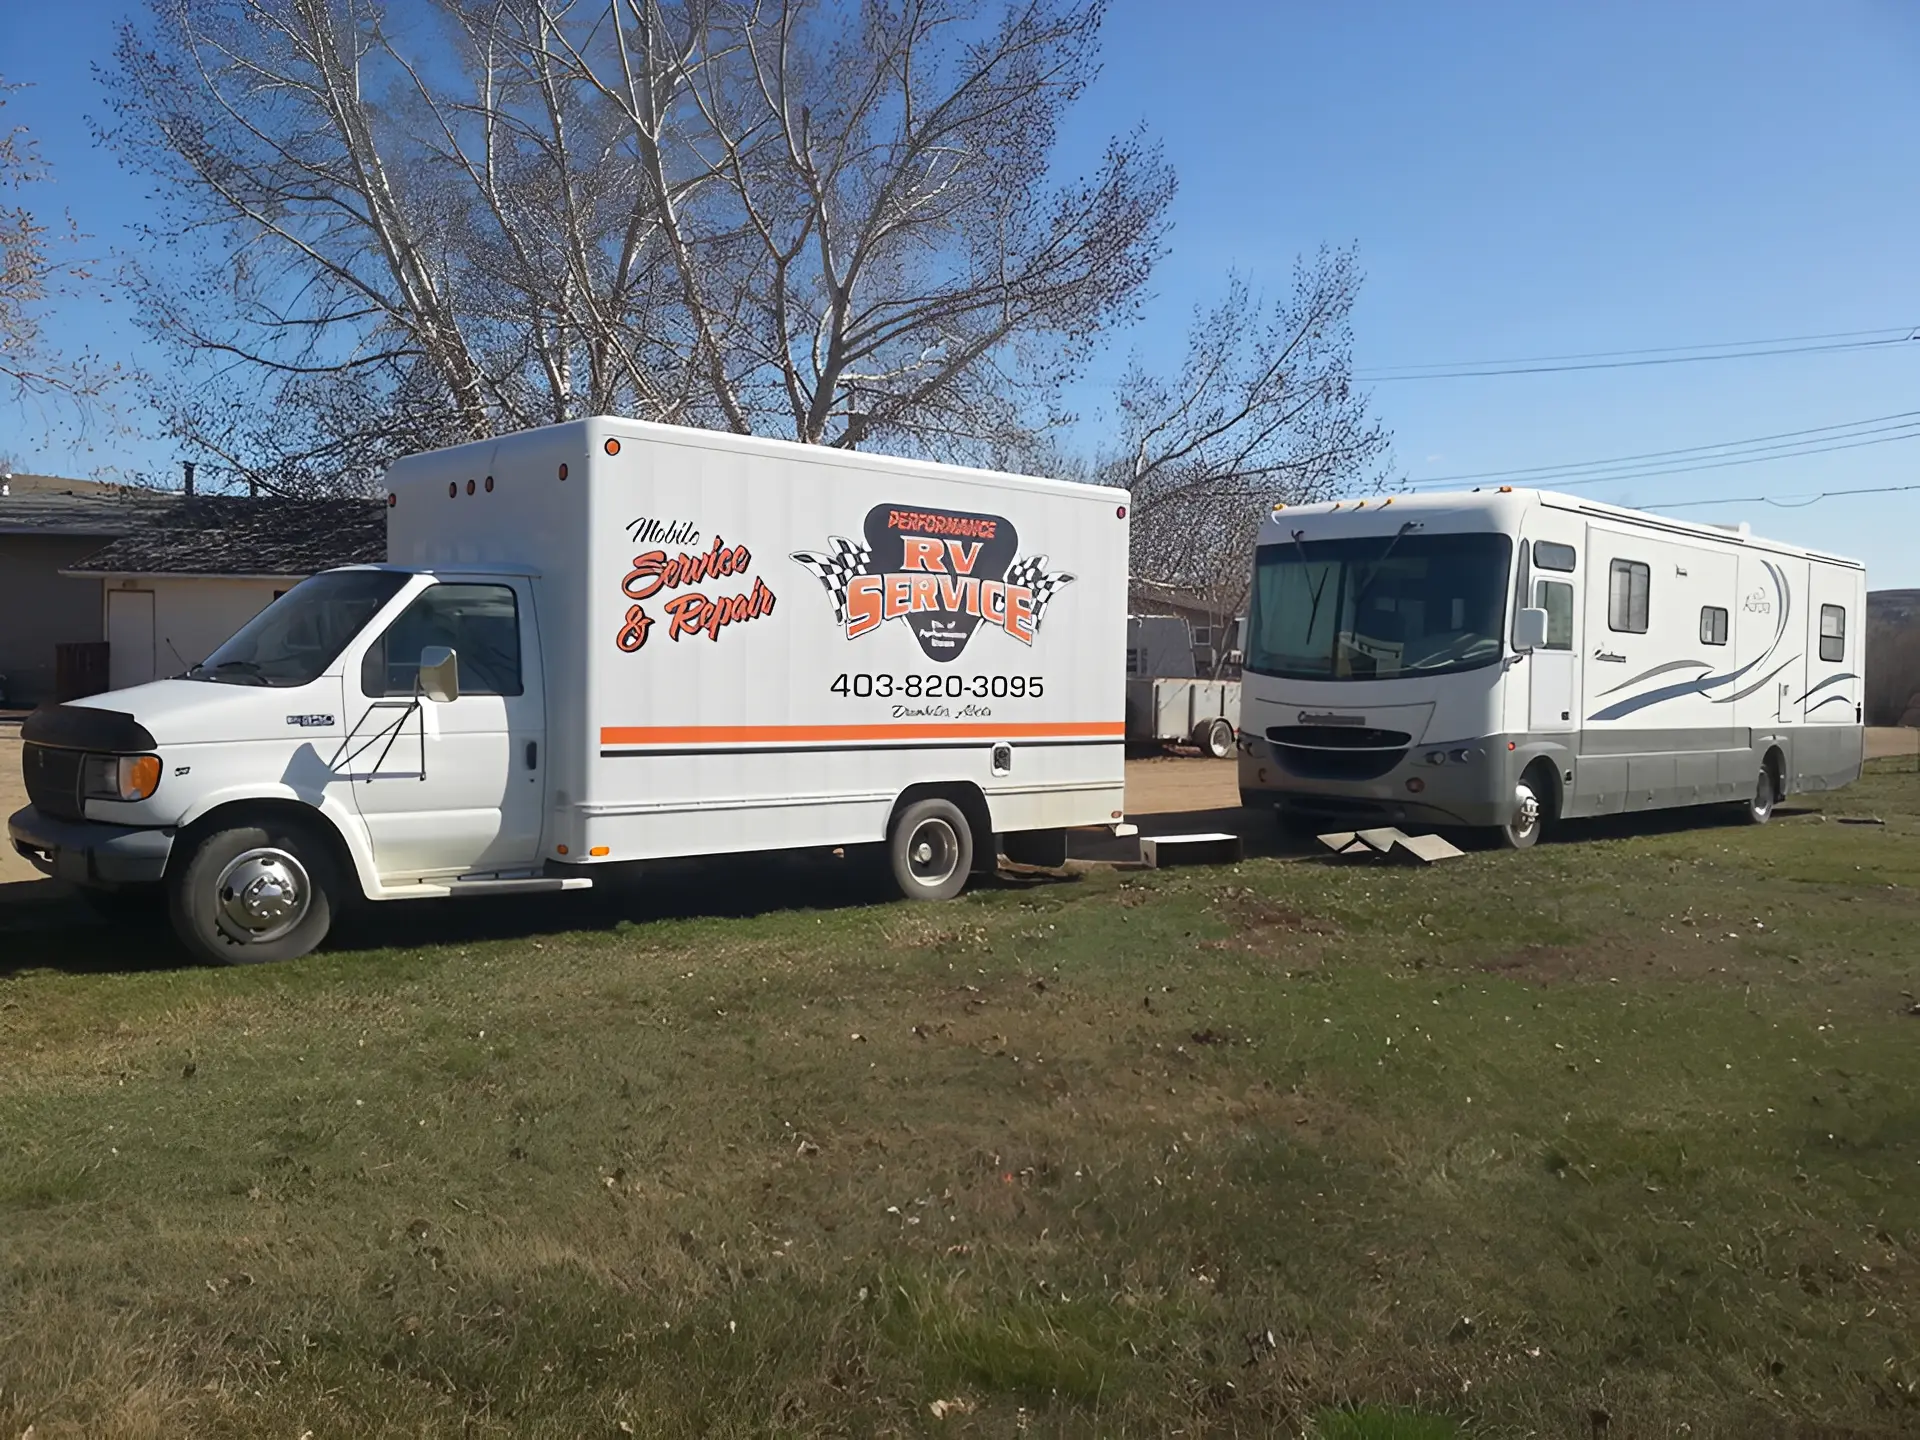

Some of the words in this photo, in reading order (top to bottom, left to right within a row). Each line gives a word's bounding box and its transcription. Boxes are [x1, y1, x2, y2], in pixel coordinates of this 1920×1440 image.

[887, 510, 997, 539] PERFORMANCE
[621, 534, 752, 600] Service
[900, 534, 984, 575] RV
[616, 604, 656, 653] &
[664, 575, 777, 642] Repair
[846, 573, 1034, 648] SERVICE
[830, 673, 1045, 698] 403-820-3095
